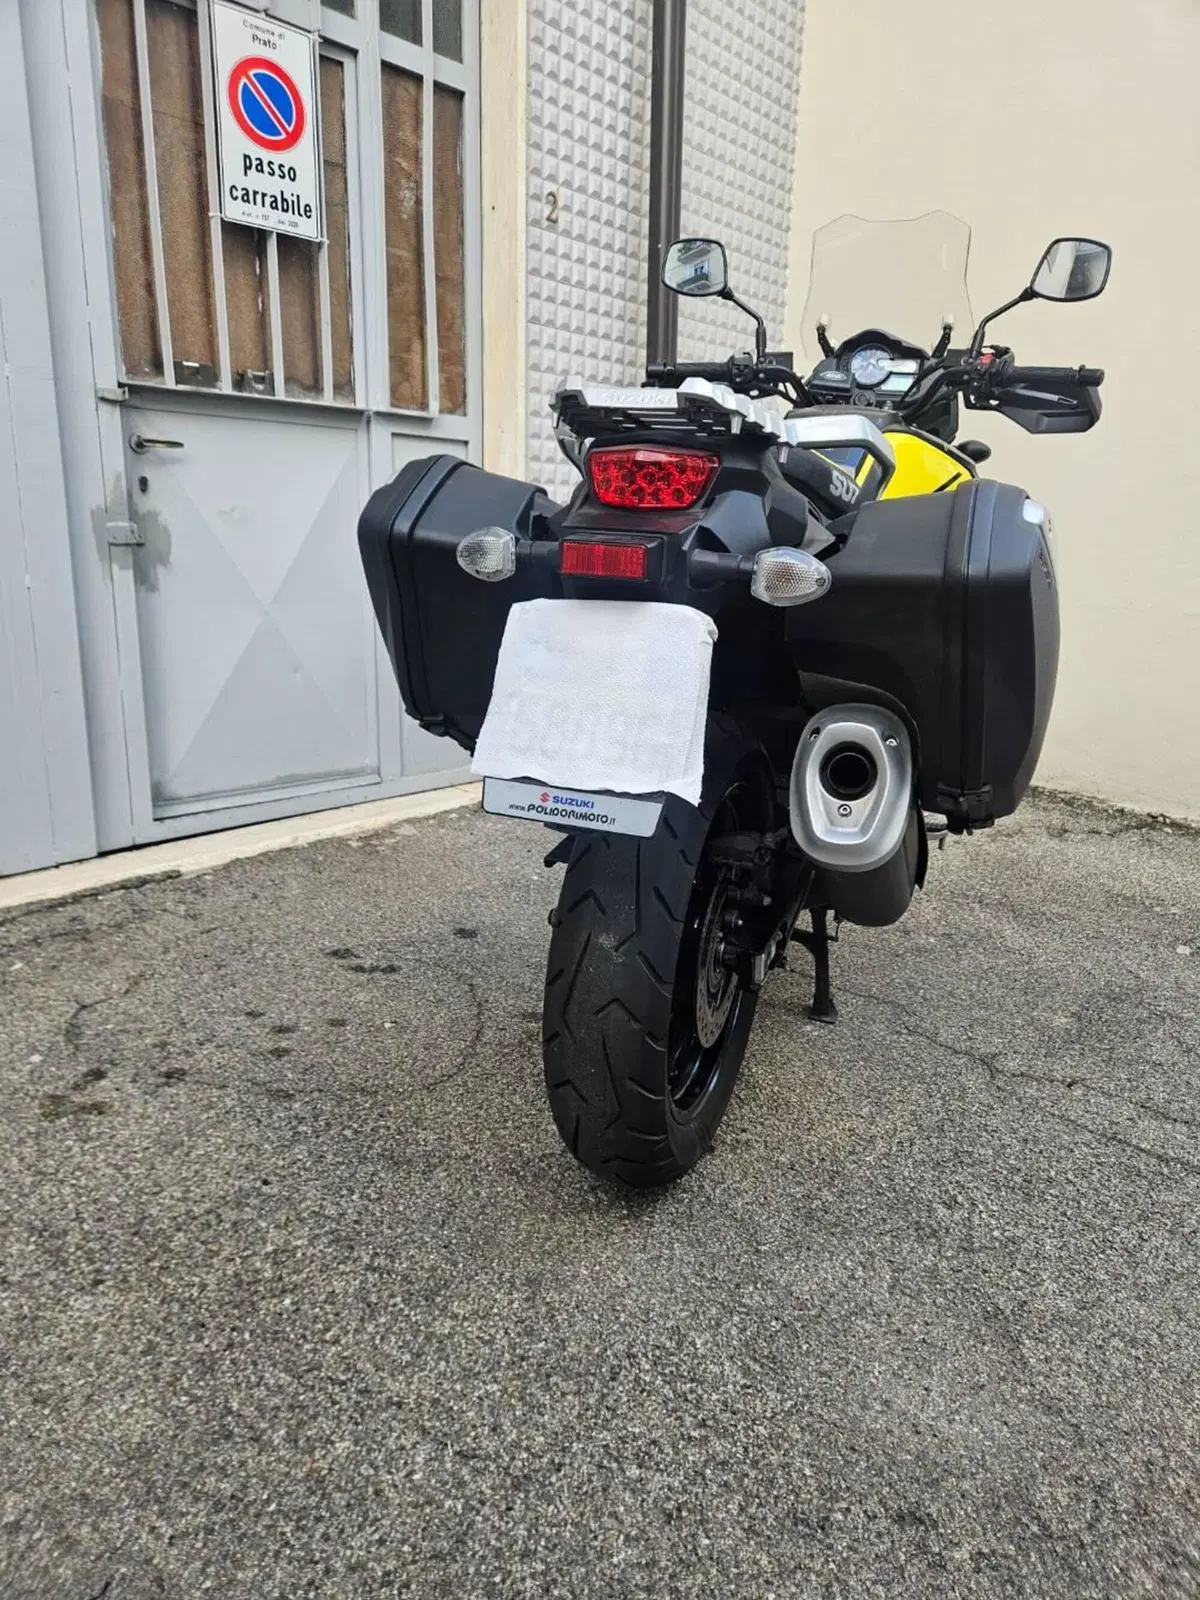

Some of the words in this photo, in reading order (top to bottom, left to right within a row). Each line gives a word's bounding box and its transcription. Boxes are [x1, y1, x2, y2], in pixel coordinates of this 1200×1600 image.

[242, 19, 276, 37] Comune
[252, 33, 278, 50] Prato
[243, 153, 297, 183] passo
[229, 184, 313, 219] carrabile
[545, 190, 559, 224] 2
[552, 795, 595, 810] SUZUKI
